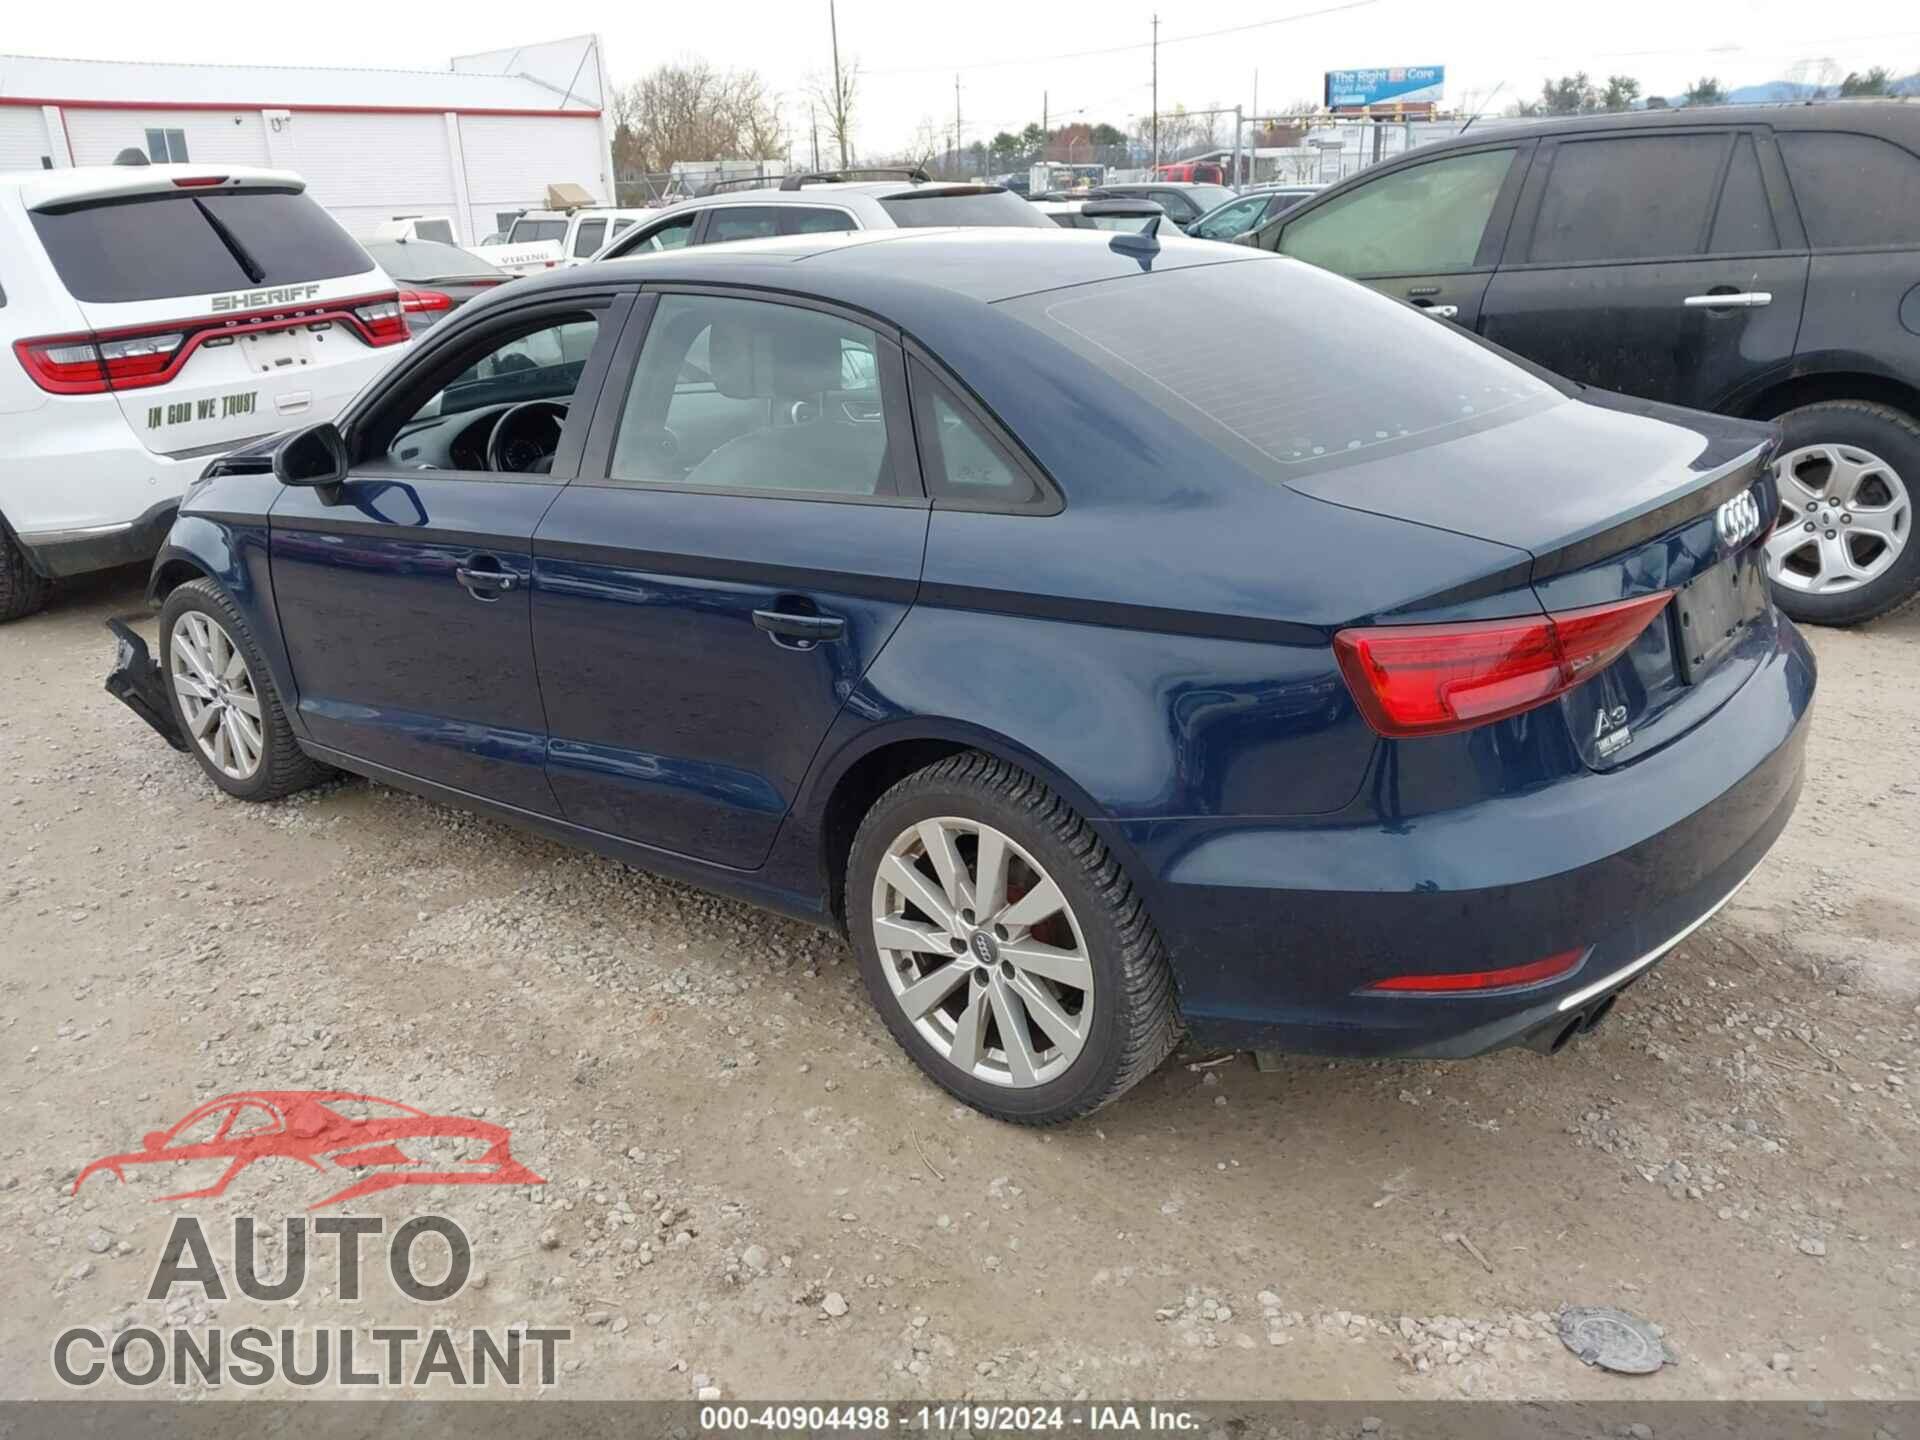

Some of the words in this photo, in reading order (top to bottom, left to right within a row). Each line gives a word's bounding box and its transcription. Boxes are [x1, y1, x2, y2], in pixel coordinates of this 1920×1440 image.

[1334, 72, 1355, 83] The
[1357, 70, 1386, 81] Right
[1407, 68, 1434, 79] Care
[501, 253, 549, 264] VIKING
[211, 284, 320, 312] SHERIFF
[148, 406, 162, 430] IN
[167, 402, 192, 425] GOD
[197, 398, 217, 420] WE
[221, 391, 258, 419] TRUST
[1594, 705, 1627, 738] A3
